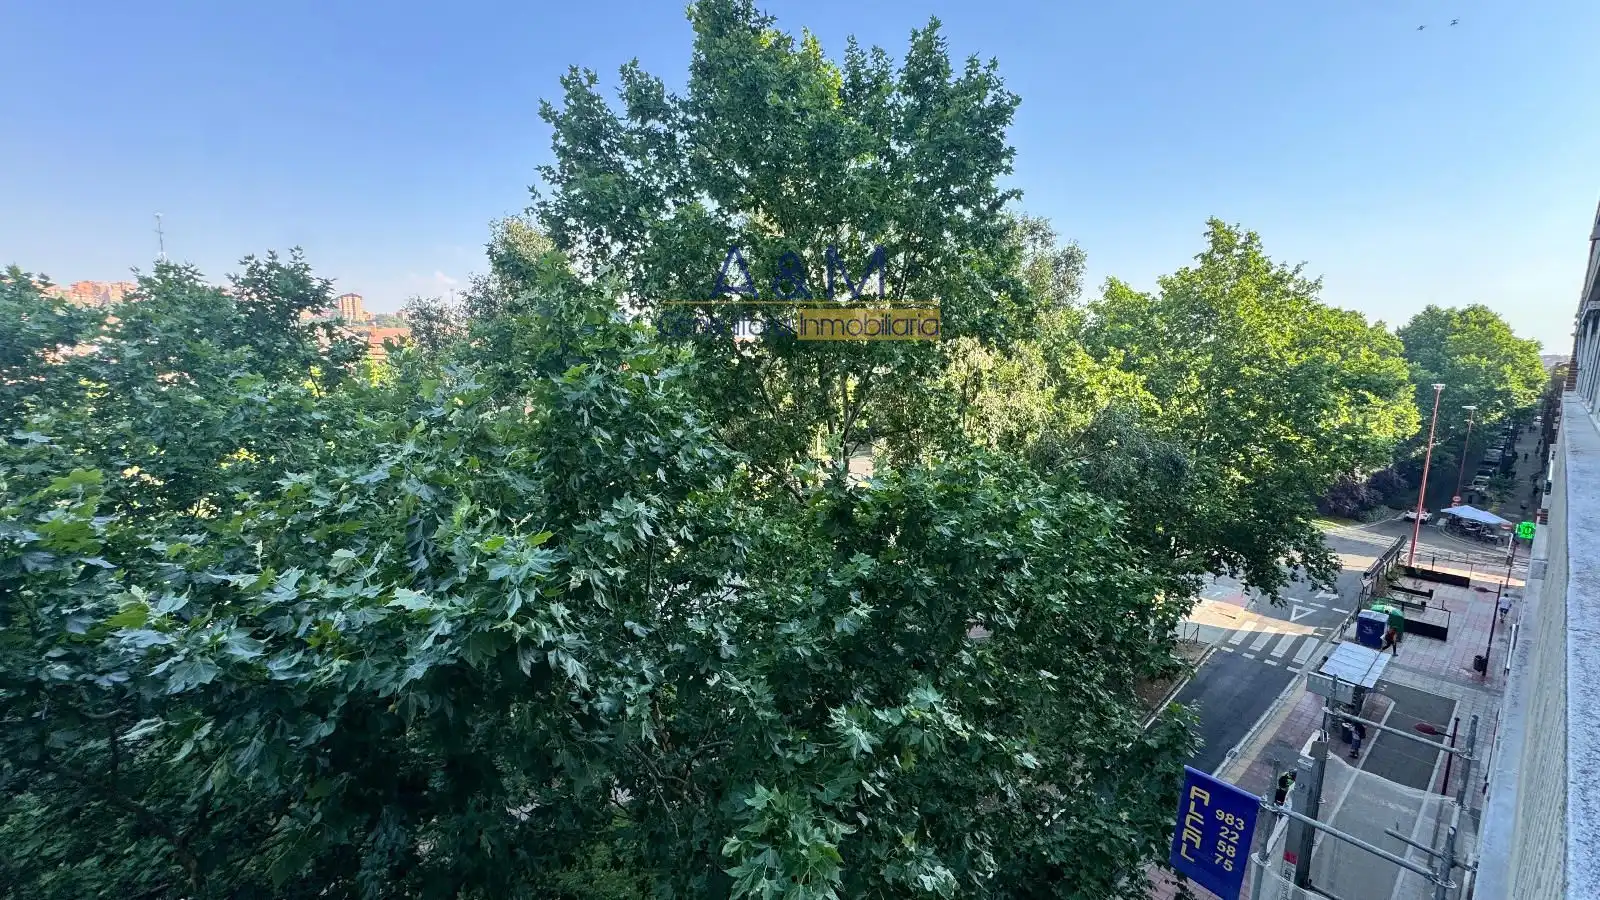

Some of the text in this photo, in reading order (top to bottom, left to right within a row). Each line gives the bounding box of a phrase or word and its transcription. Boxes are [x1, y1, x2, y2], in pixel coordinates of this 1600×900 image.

[1215, 809, 1245, 831] 983
[1218, 826, 1240, 844] 22
[1216, 840, 1236, 858] 58
[1214, 853, 1234, 872] 75
